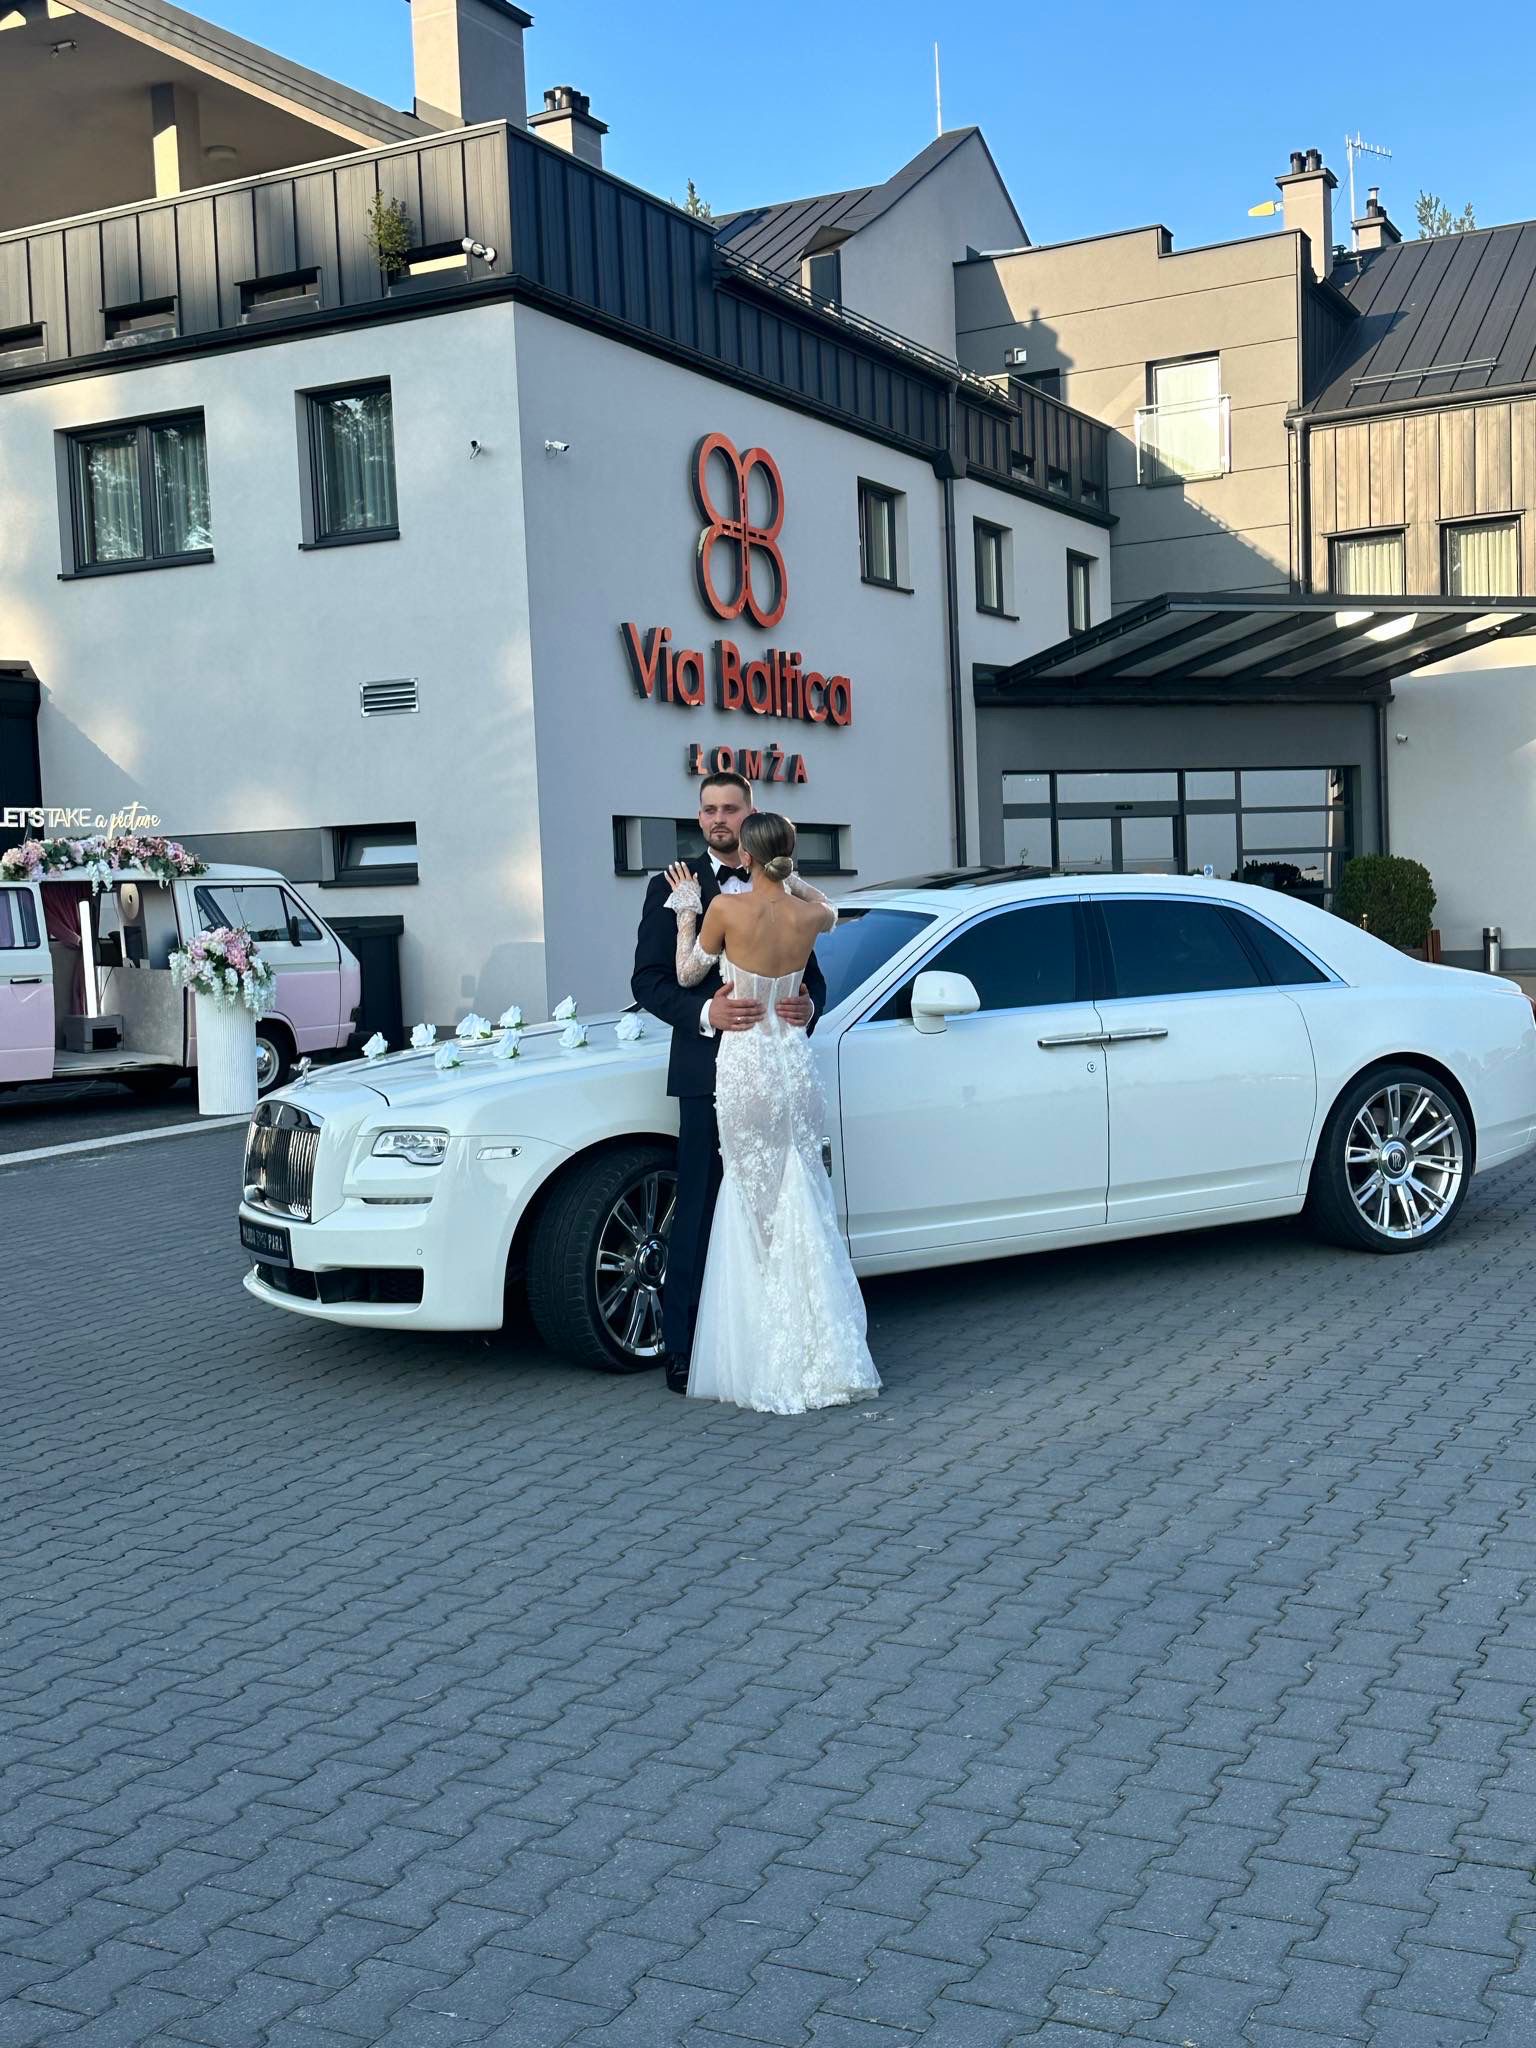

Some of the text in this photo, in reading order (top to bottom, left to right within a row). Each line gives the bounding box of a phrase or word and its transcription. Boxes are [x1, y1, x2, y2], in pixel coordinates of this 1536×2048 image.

[621, 622, 852, 726] Via Baltica
[688, 743, 808, 783] ŁOMŻA
[43, 807, 92, 828] TAKE
[95, 816, 107, 828] a
